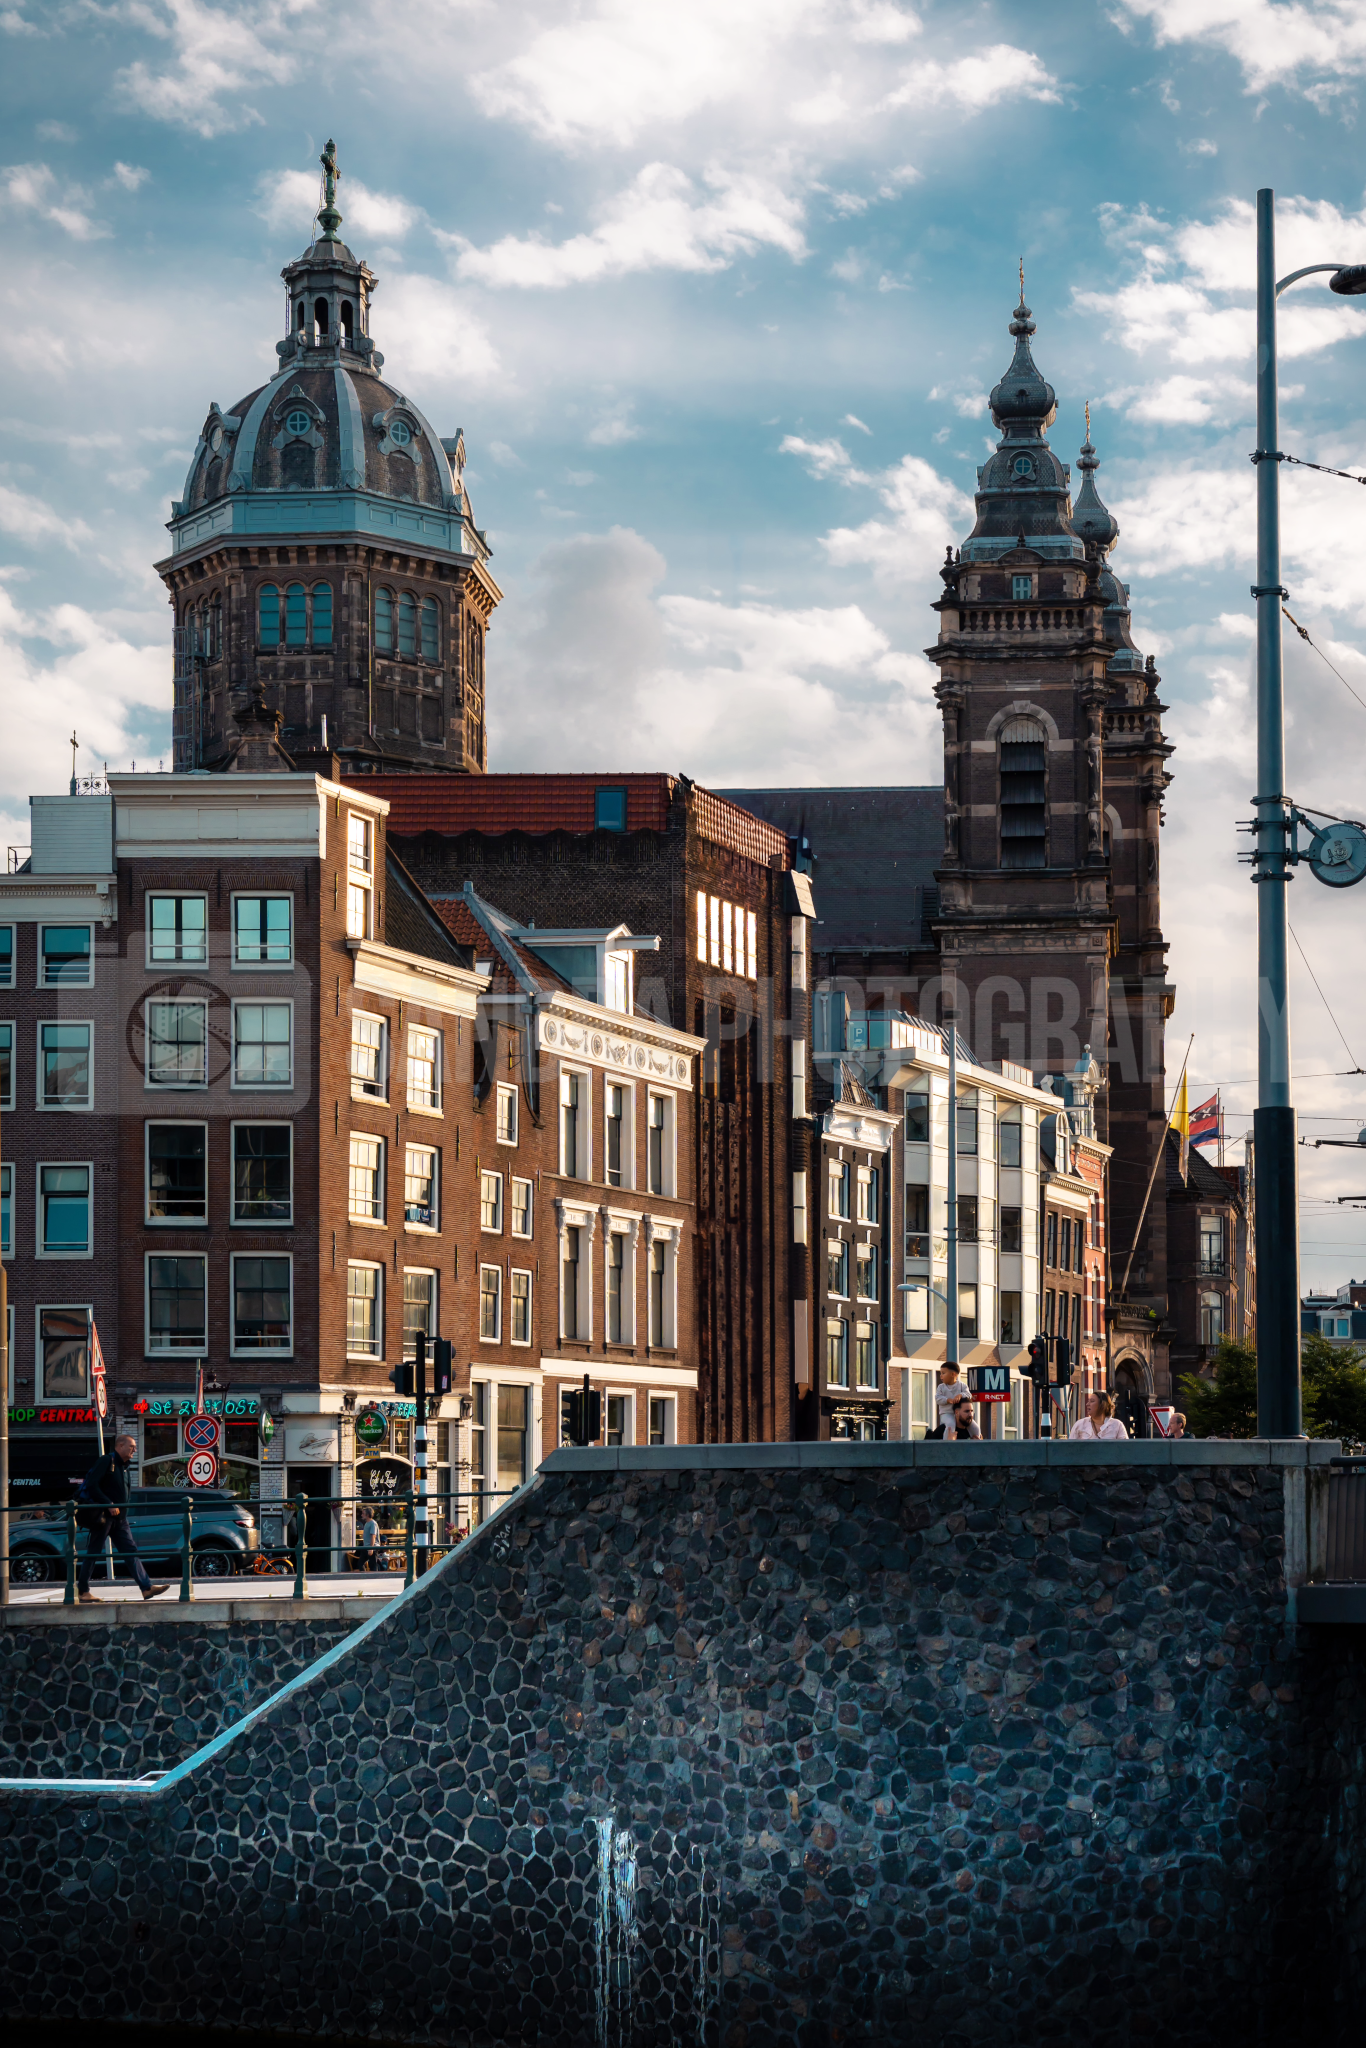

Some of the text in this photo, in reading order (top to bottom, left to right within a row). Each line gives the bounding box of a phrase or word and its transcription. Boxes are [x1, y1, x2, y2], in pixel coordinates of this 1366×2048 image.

[855, 1028, 863, 1037] P
[984, 1368, 1005, 1390] M
[8, 1408, 36, 1422] HOP
[364, 1449, 380, 1457] ATM
[193, 1462, 212, 1475] 30
[12, 1478, 42, 1487] CENTRAL
